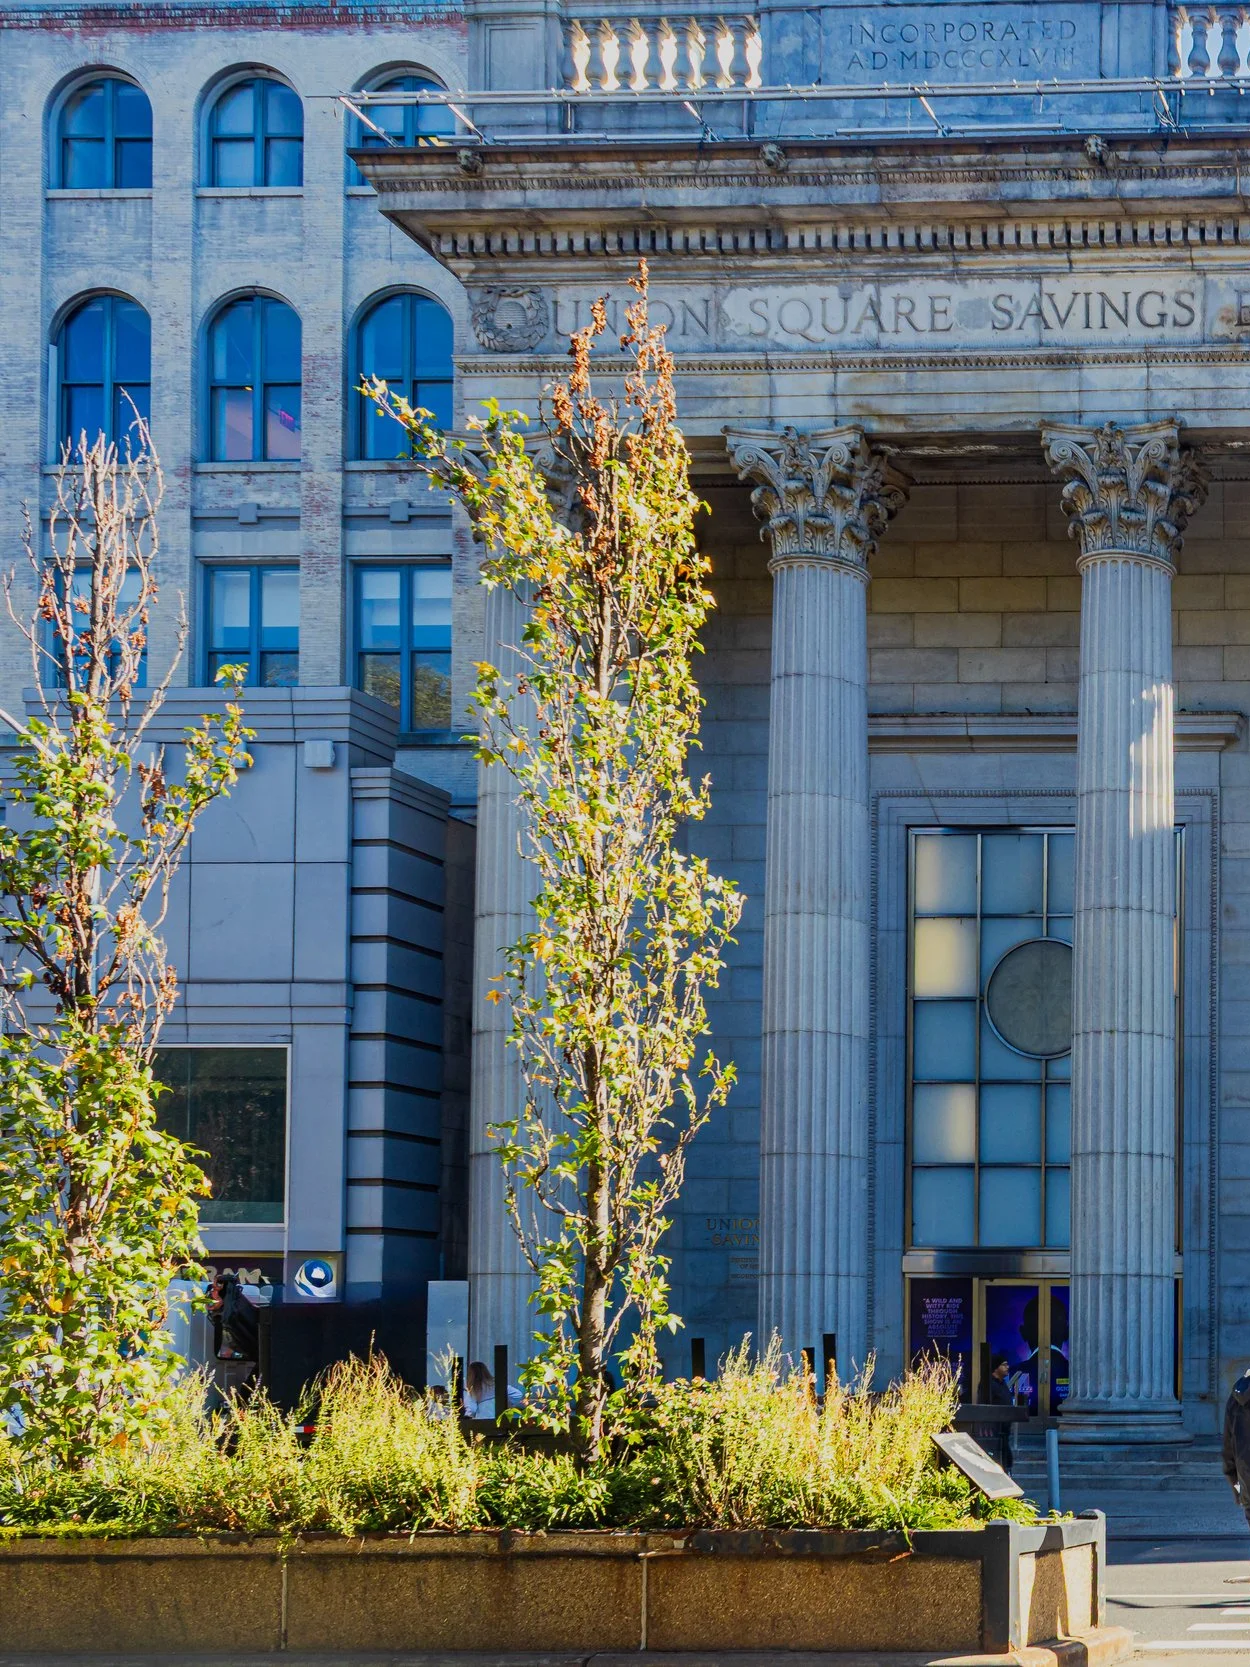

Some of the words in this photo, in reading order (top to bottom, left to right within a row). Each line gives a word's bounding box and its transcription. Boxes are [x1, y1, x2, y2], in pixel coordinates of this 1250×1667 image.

[848, 19, 1077, 45] INCORPORATED
[748, 295, 954, 343] SQUARE
[991, 289, 1196, 331] SAVINGS
